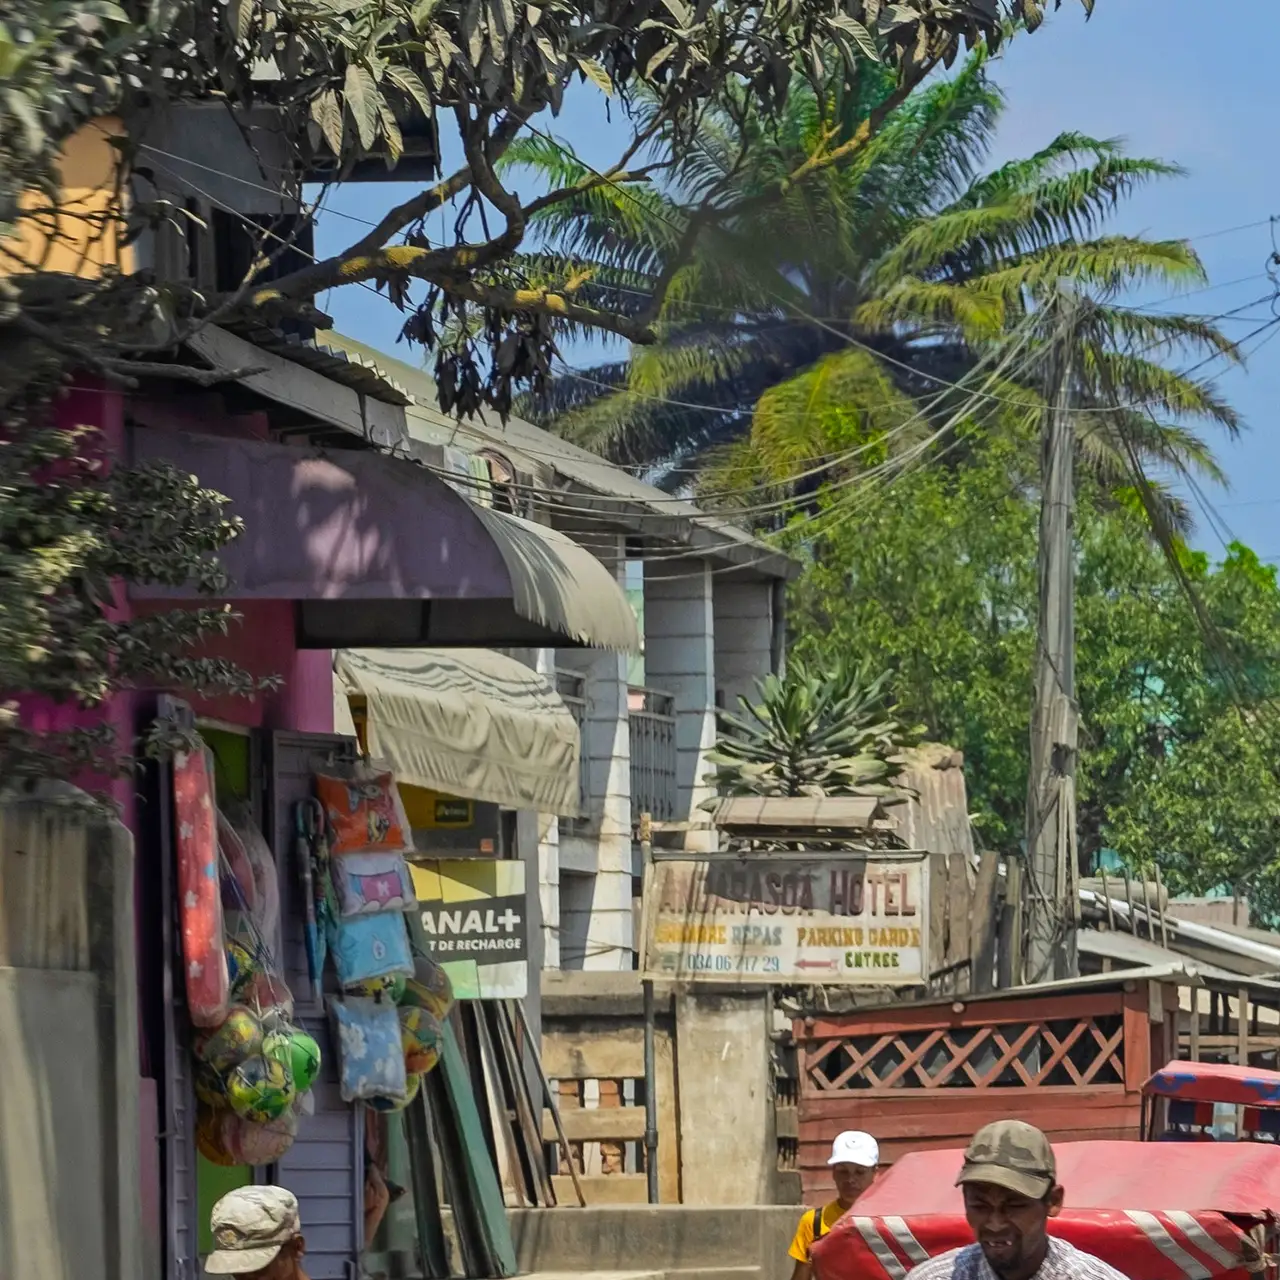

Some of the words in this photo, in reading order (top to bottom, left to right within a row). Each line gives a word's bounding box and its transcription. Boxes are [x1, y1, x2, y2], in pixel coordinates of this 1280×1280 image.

[829, 869, 916, 917] HOTEL
[438, 939, 455, 952] DE
[456, 937, 522, 952] RECHARGE
[731, 925, 783, 947] REPAS
[796, 926, 863, 948] PARKING
[687, 953, 712, 971] 034
[716, 954, 732, 971] 06
[762, 955, 780, 973] 29
